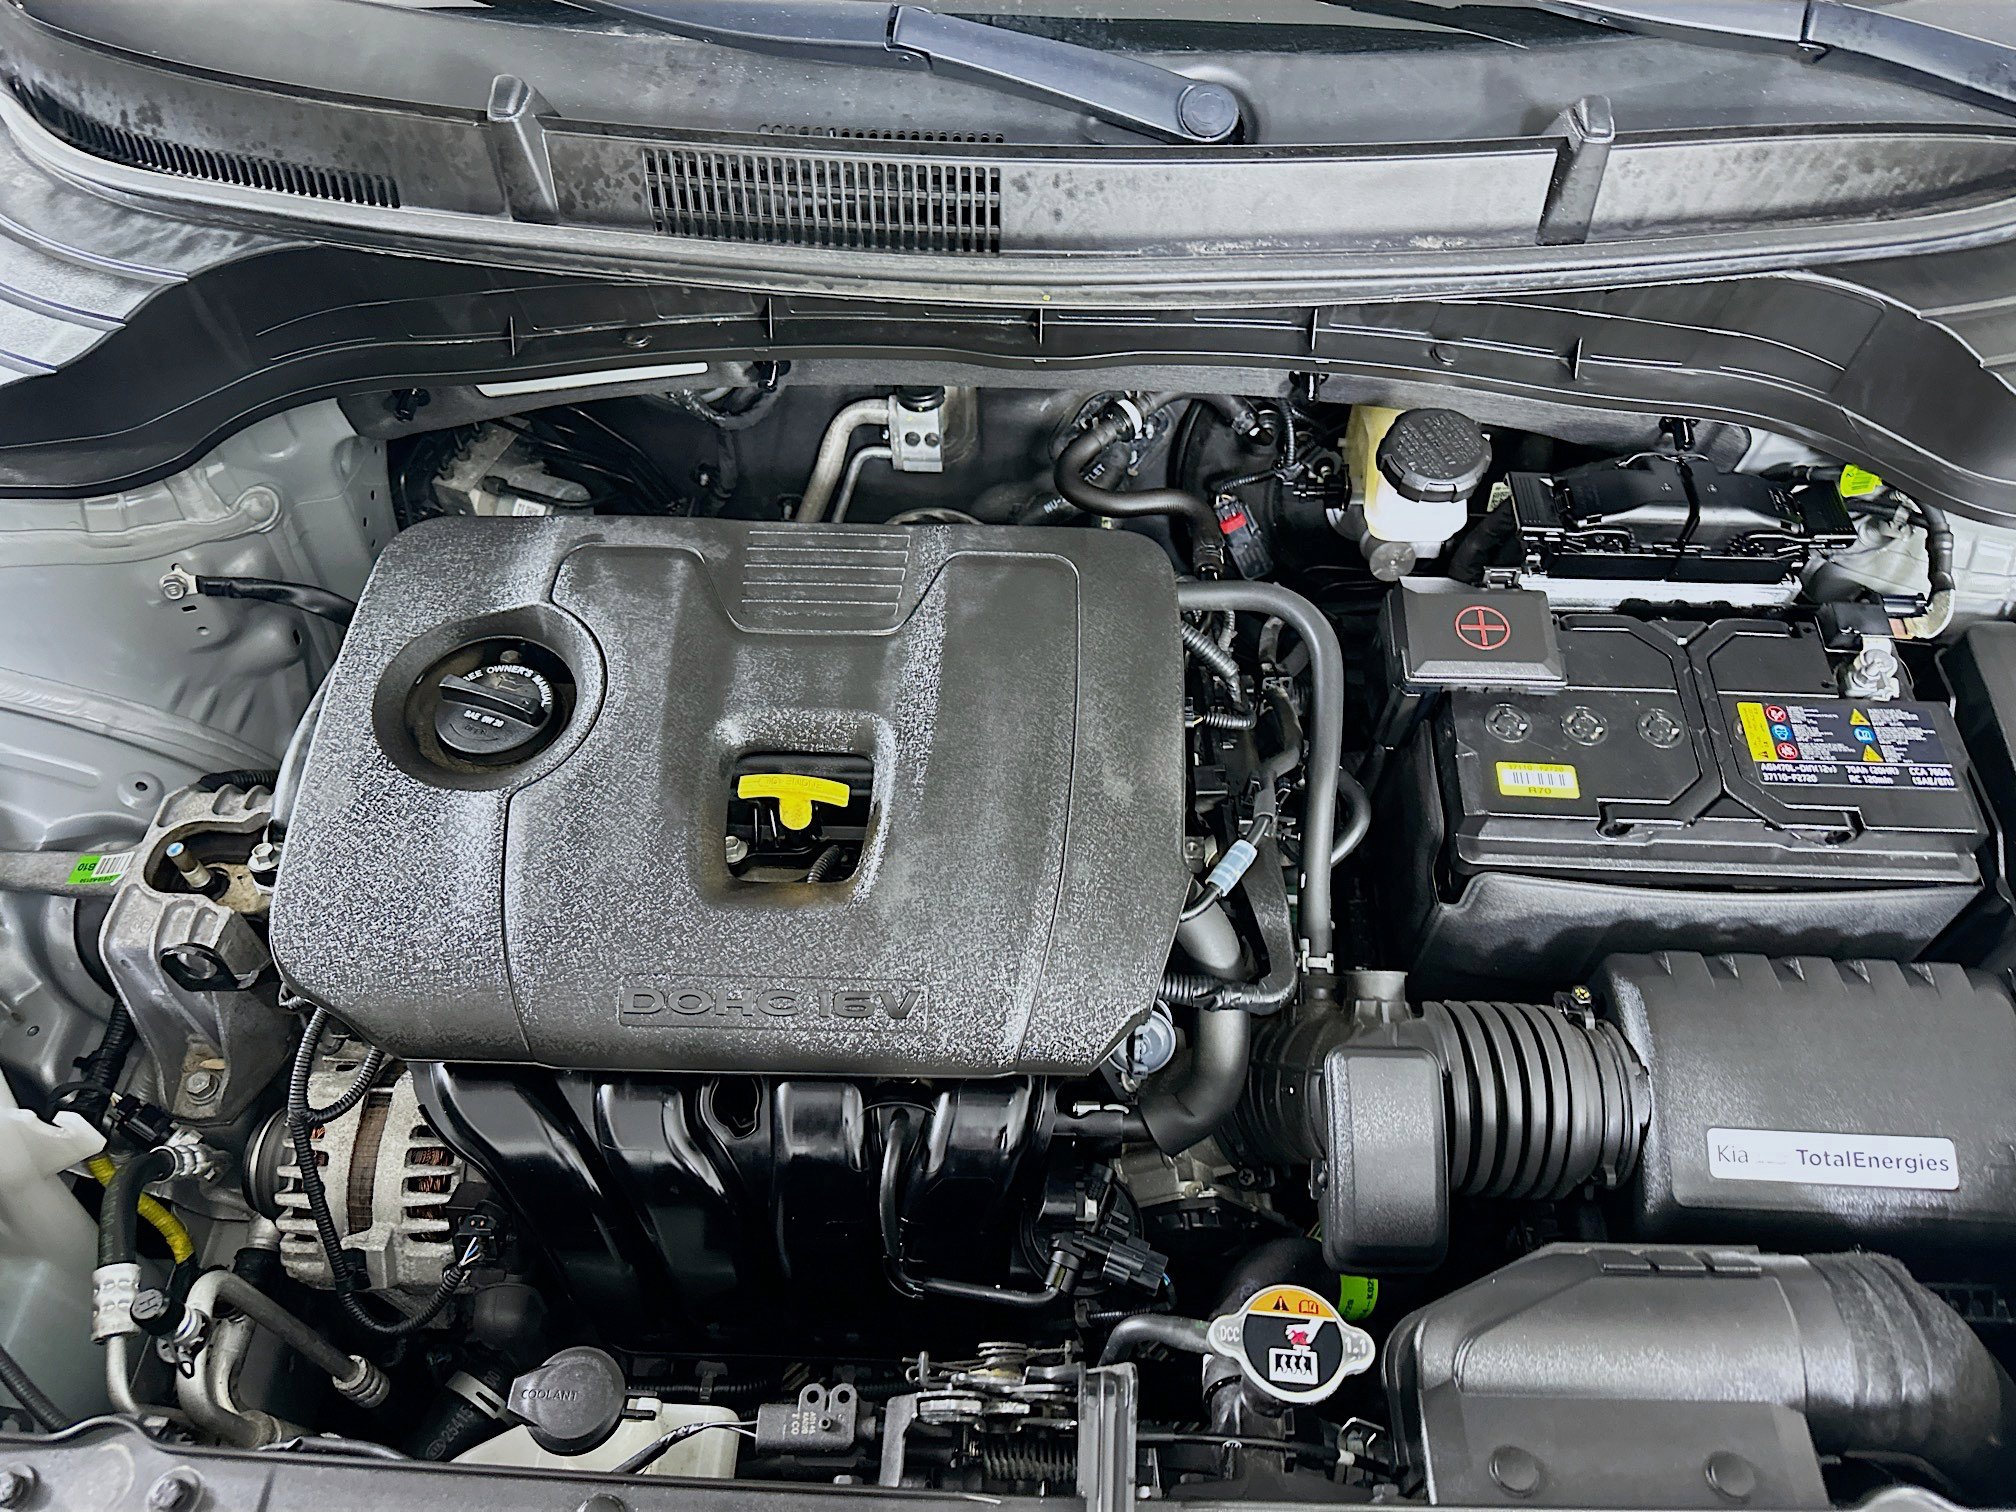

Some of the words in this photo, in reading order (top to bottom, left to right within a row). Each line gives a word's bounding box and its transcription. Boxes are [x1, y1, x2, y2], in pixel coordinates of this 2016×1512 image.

[486, 665, 533, 677] OWNER'S
[531, 674, 552, 708] MANUAL
[463, 710, 481, 720] SAE
[1528, 786, 1552, 795] R70
[622, 986, 801, 1016] DOHC
[818, 989, 921, 1020] 16V
[1716, 1144, 1750, 1164] Kia
[1796, 1149, 1949, 1174] TotalEnergies
[1220, 1325, 1240, 1342] DCC
[1345, 1335, 1366, 1354] 1.1
[520, 1388, 579, 1401] COOLANT
